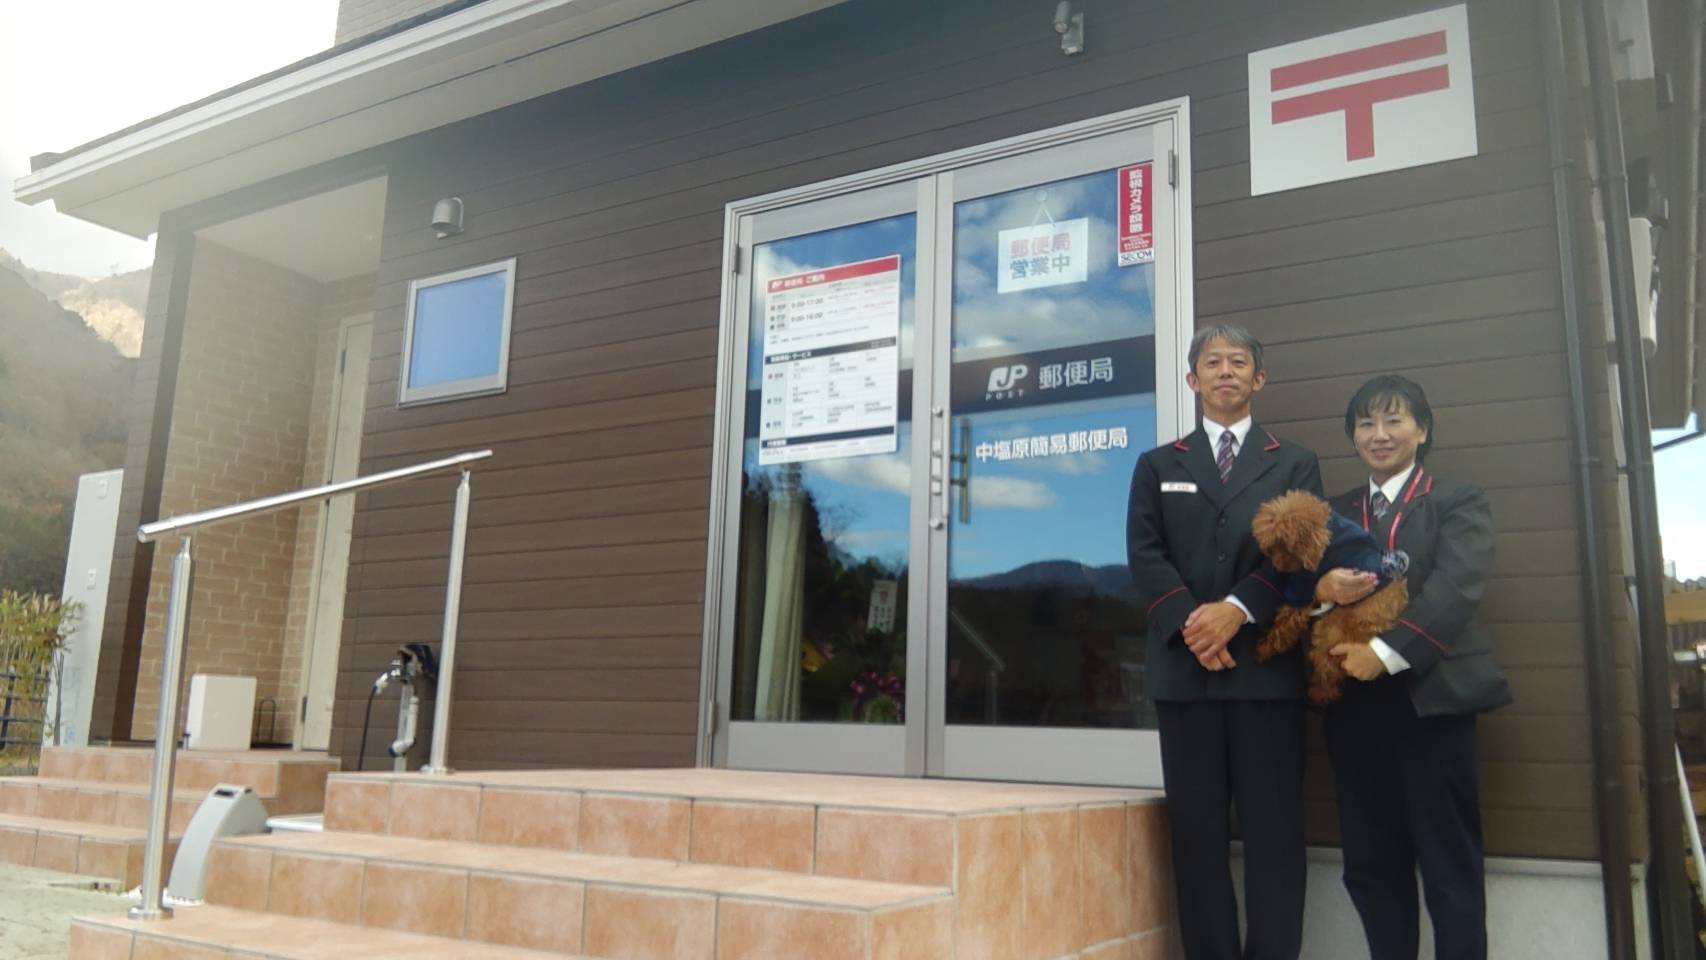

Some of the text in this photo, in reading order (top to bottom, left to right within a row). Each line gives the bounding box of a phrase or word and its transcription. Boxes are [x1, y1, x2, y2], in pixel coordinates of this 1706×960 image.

[1010, 233, 1071, 259] 郵便局
[1121, 250, 1152, 260] SECOM
[1009, 253, 1070, 280] 営業中
[987, 364, 1028, 391] JP
[1038, 357, 1113, 389] 郵便局
[985, 389, 1025, 401] POST
[975, 426, 1128, 463] 中塩原簡易郵便局
